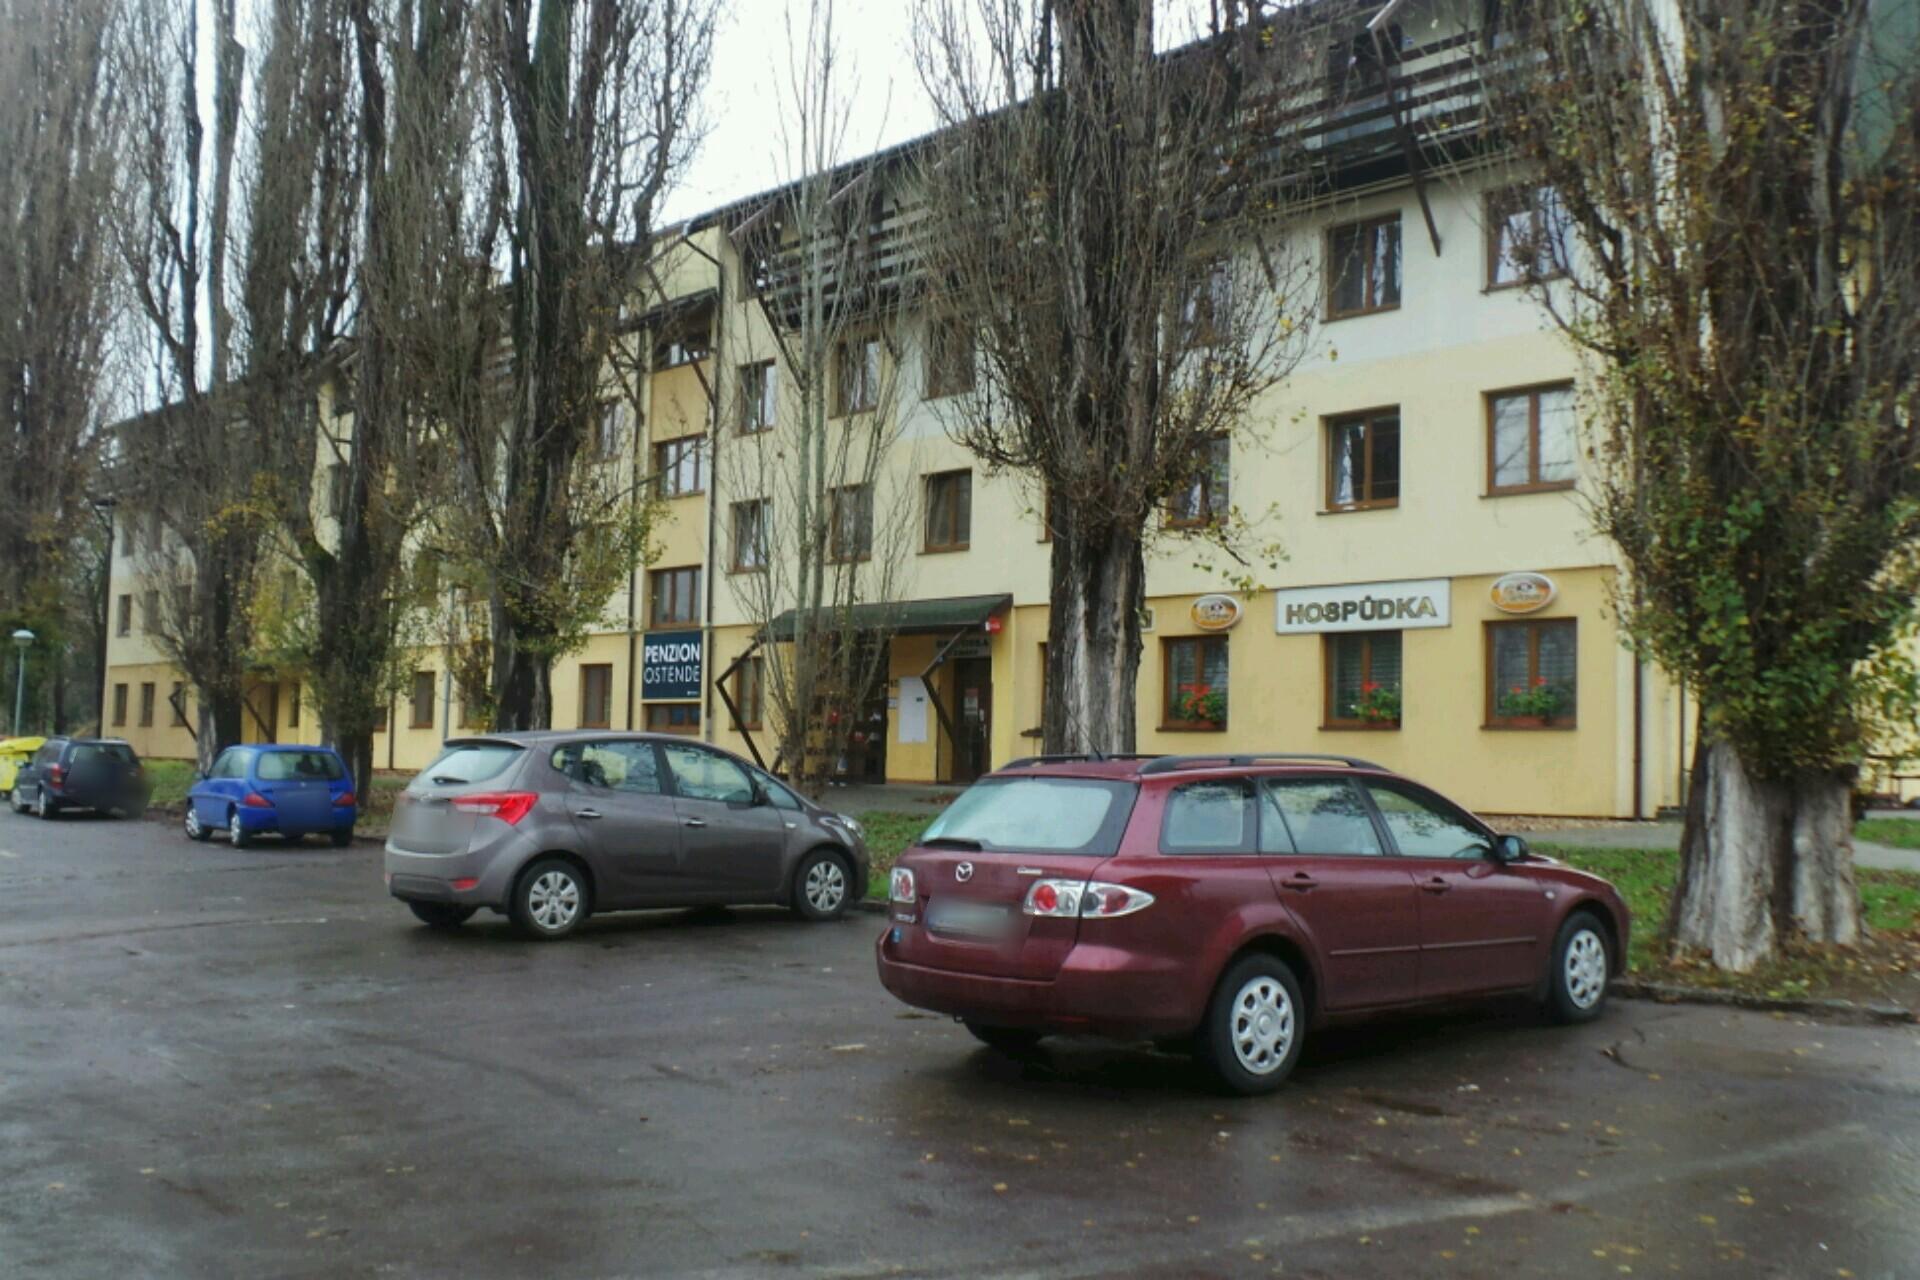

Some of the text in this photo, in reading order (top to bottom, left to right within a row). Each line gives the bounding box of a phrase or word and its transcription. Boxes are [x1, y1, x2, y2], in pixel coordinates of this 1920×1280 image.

[1286, 595, 1438, 625] HOSPŮDKA
[645, 643, 700, 664] PENZION
[644, 665, 700, 684] OSTENDE
